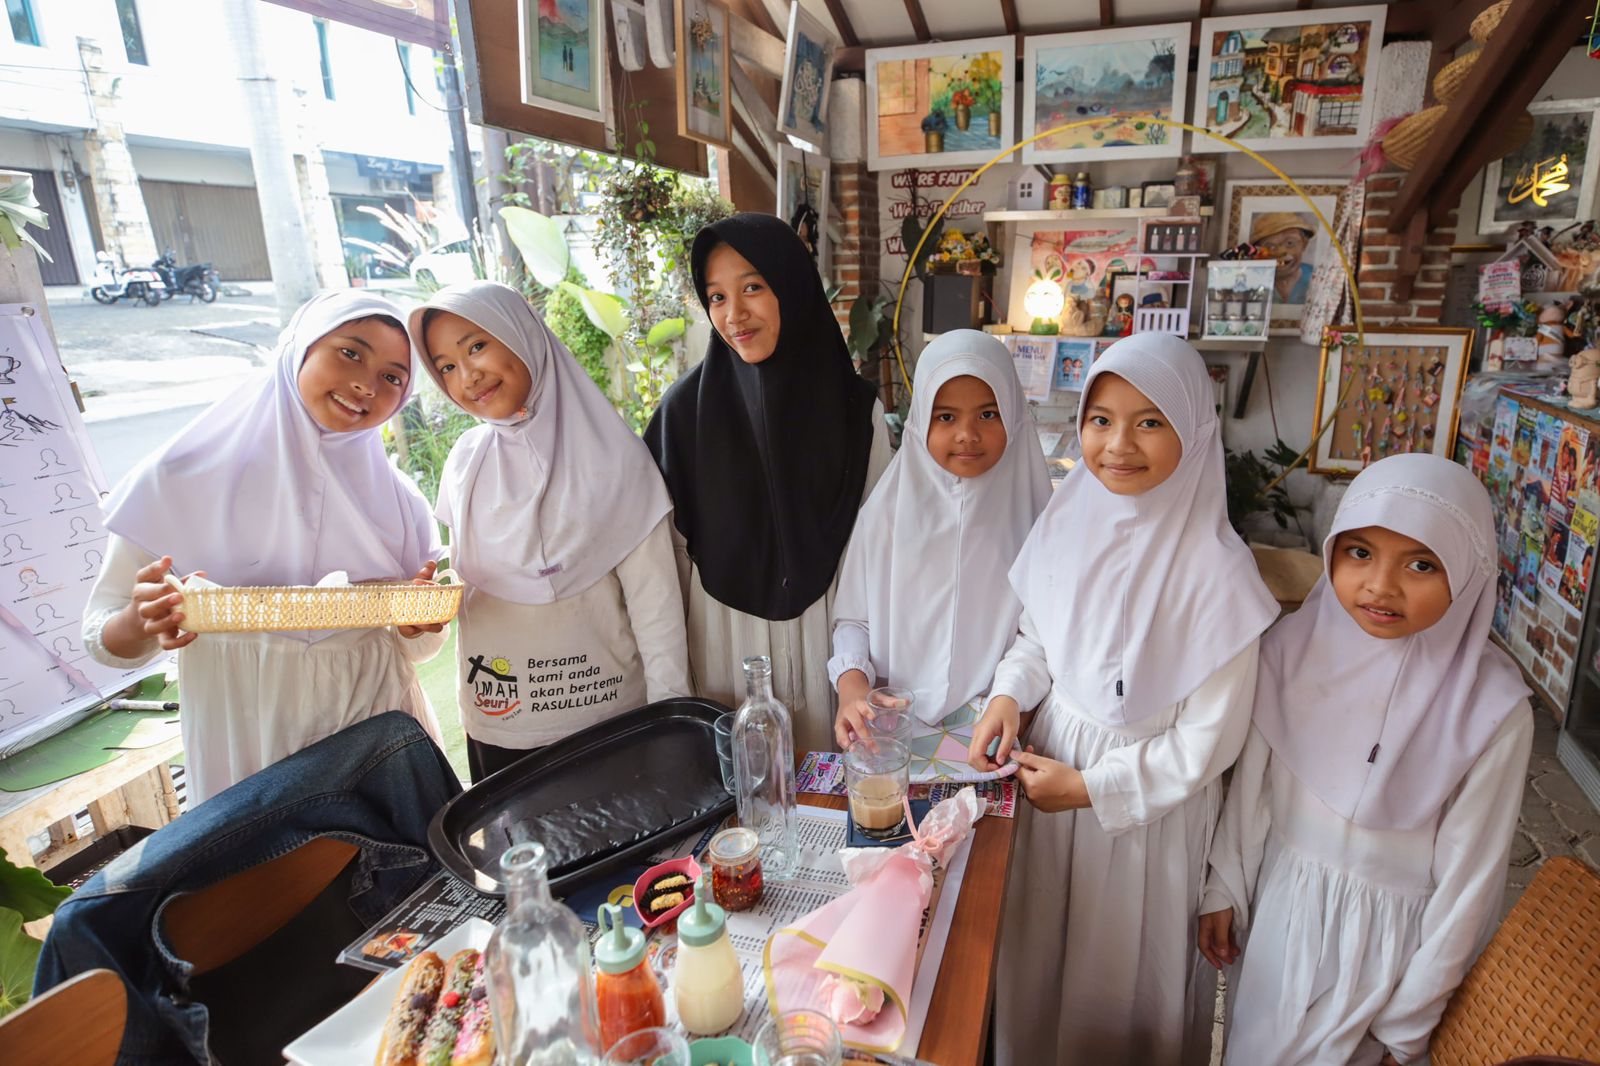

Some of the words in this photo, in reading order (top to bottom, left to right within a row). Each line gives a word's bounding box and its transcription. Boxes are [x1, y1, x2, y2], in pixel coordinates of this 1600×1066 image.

[527, 654, 587, 669] Bersama
[528, 671, 563, 684] kami
[568, 666, 601, 680] anda
[530, 686, 564, 699] akan
[569, 674, 623, 692] bertemu
[474, 692, 509, 709] Seuri
[531, 689, 618, 712] RASULLULAH
